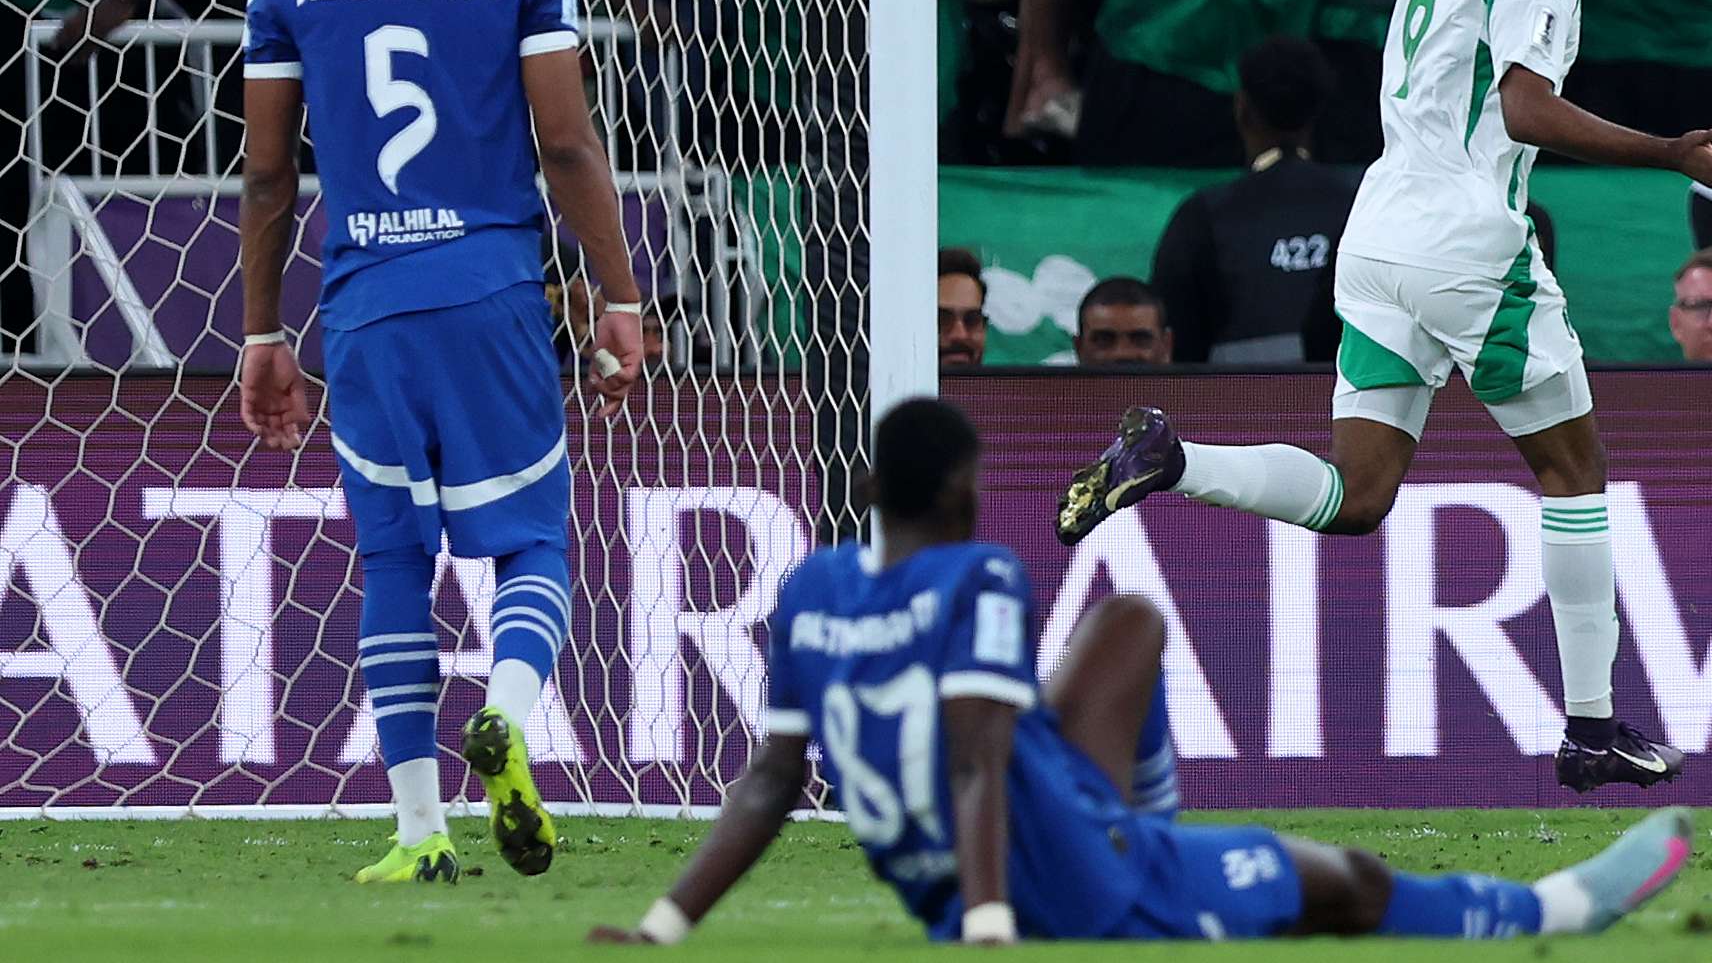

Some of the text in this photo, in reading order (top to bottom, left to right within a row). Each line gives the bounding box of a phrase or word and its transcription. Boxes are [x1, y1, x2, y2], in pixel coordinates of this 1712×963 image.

[364, 25, 437, 196] 5
[378, 229, 465, 244] FOUNDATION
[823, 663, 946, 847] 87
